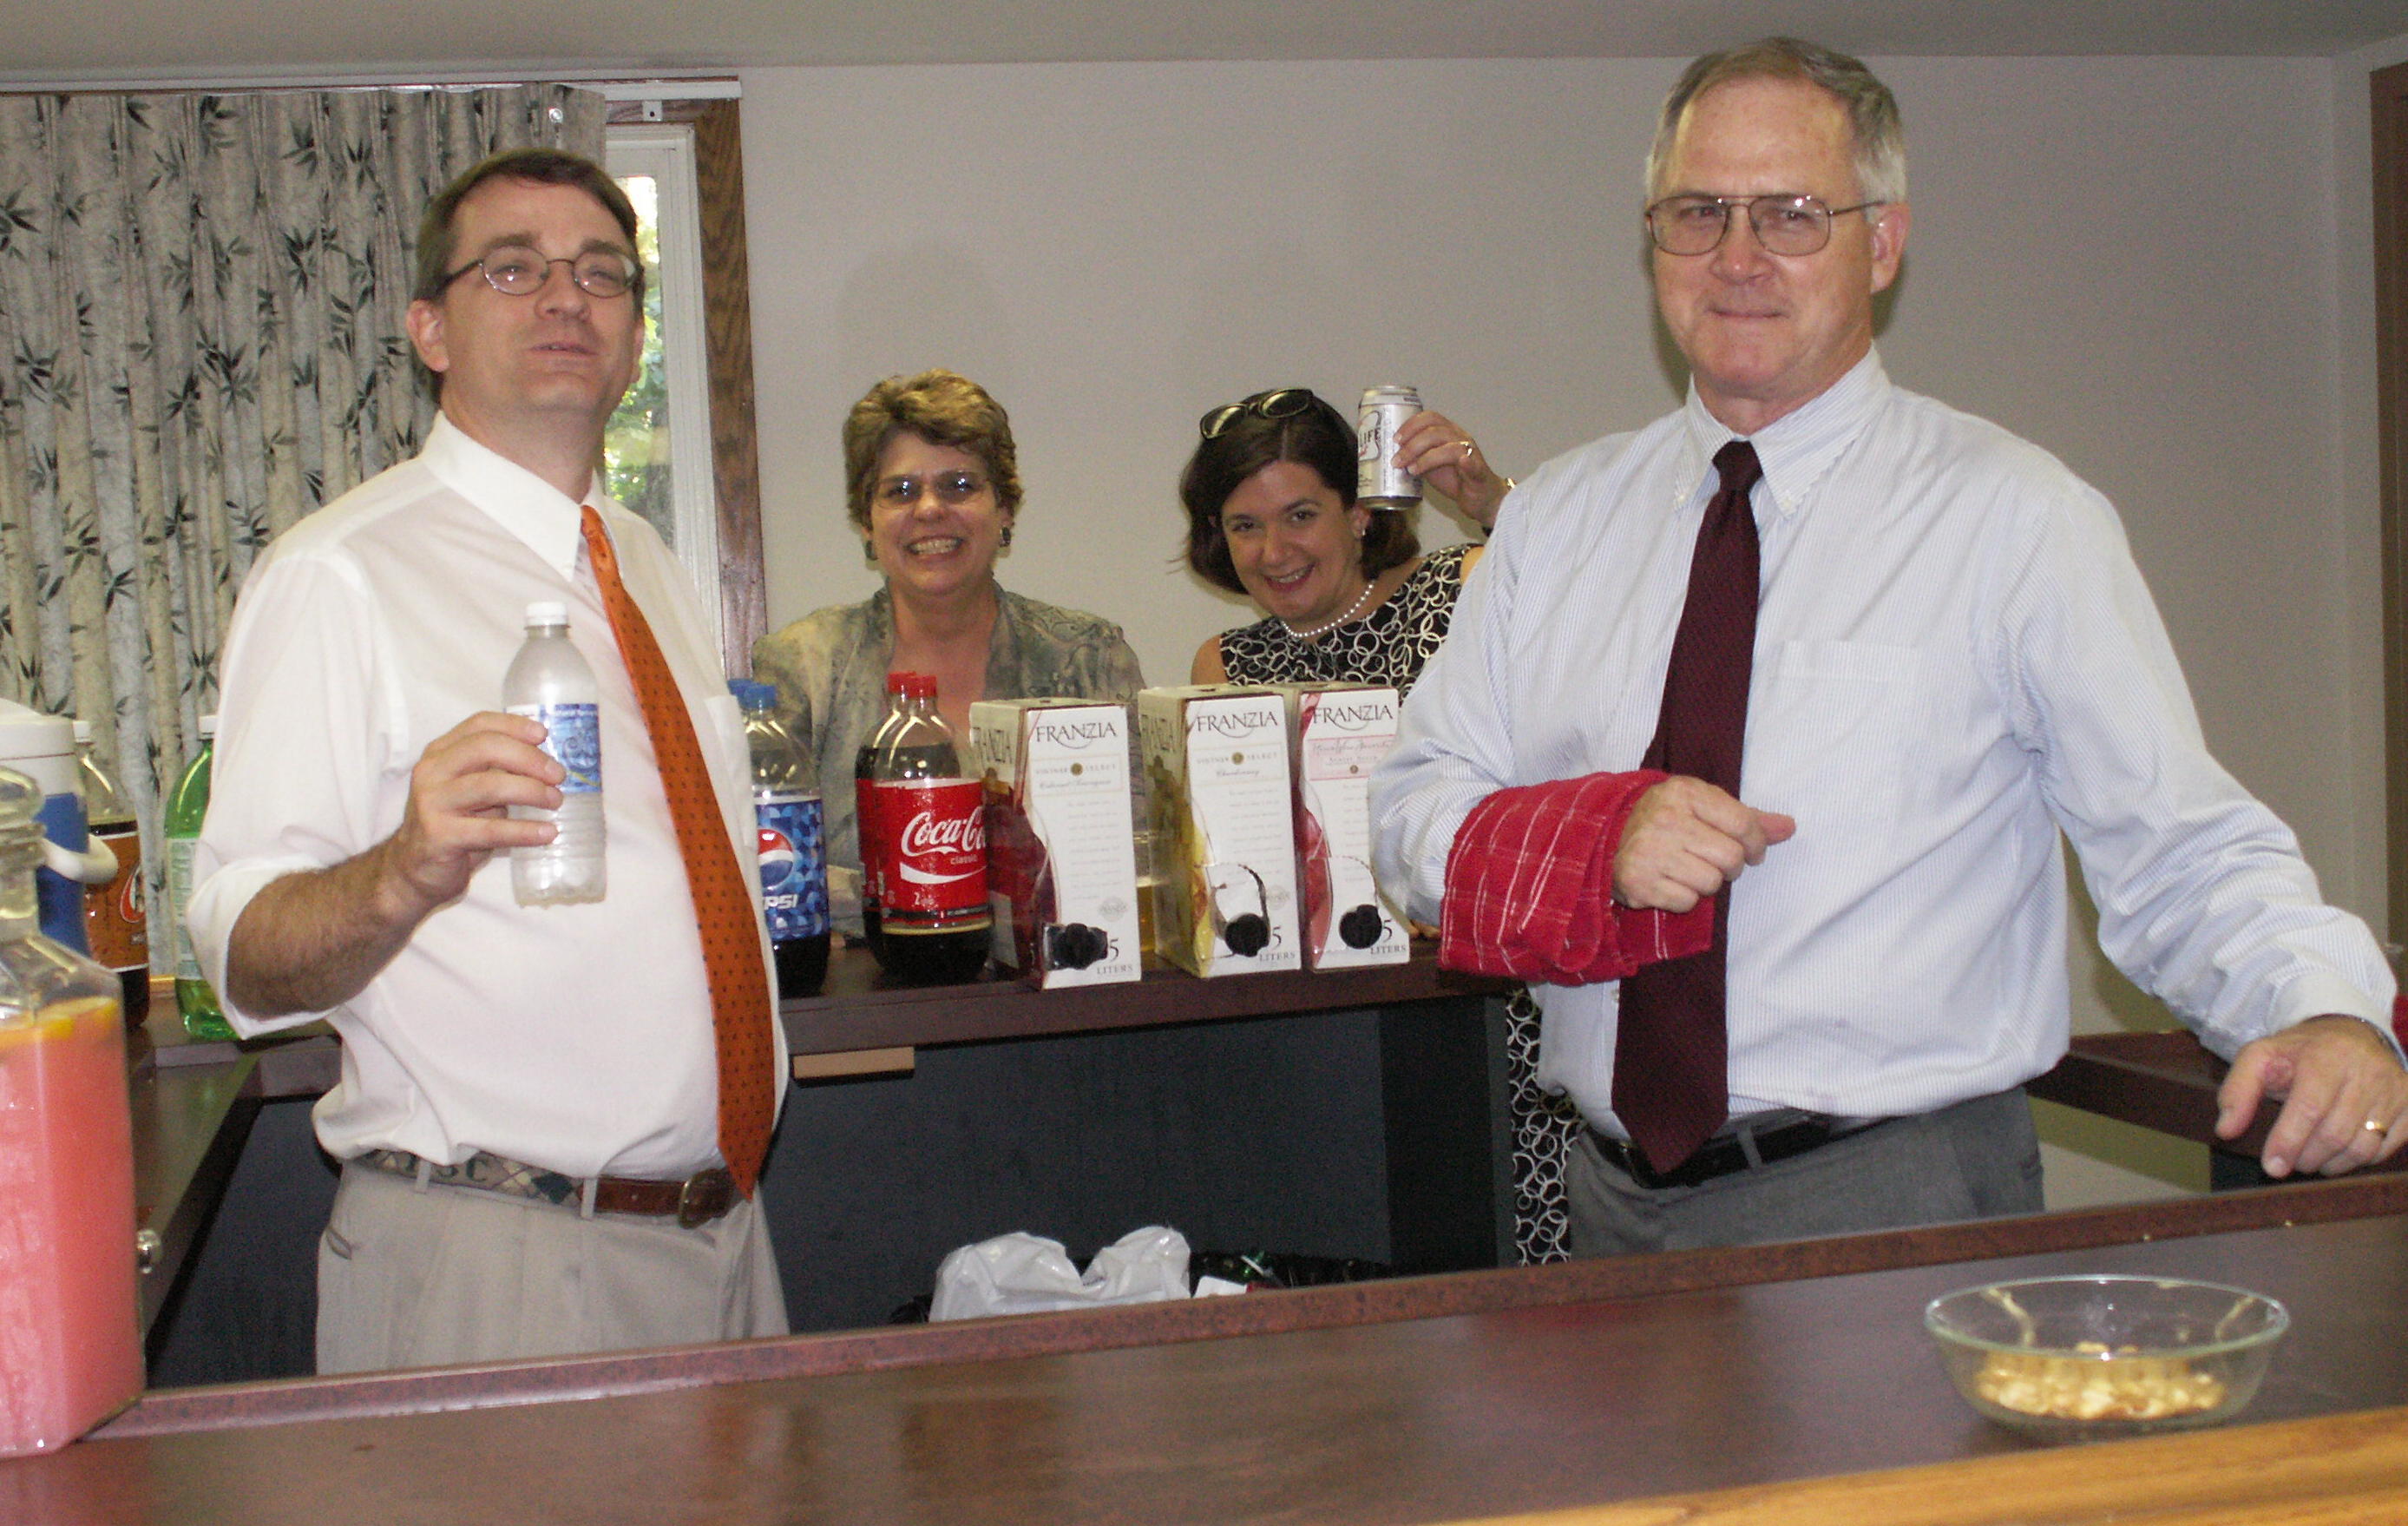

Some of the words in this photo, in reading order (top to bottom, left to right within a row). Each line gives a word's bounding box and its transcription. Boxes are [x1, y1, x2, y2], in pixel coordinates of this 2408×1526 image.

[1197, 711, 1278, 738] FRANZIA
[1312, 704, 1394, 731] FRANZIA
[1036, 721, 1118, 749] FRANZIA
[763, 893, 798, 911] PSI
[1271, 925, 1282, 950] 5
[1382, 918, 1393, 944] 5
[1109, 938, 1119, 963] 5
[1259, 951, 1296, 962] LITERS
[1370, 944, 1407, 954] LITERS
[1096, 964, 1133, 974] LITERS
